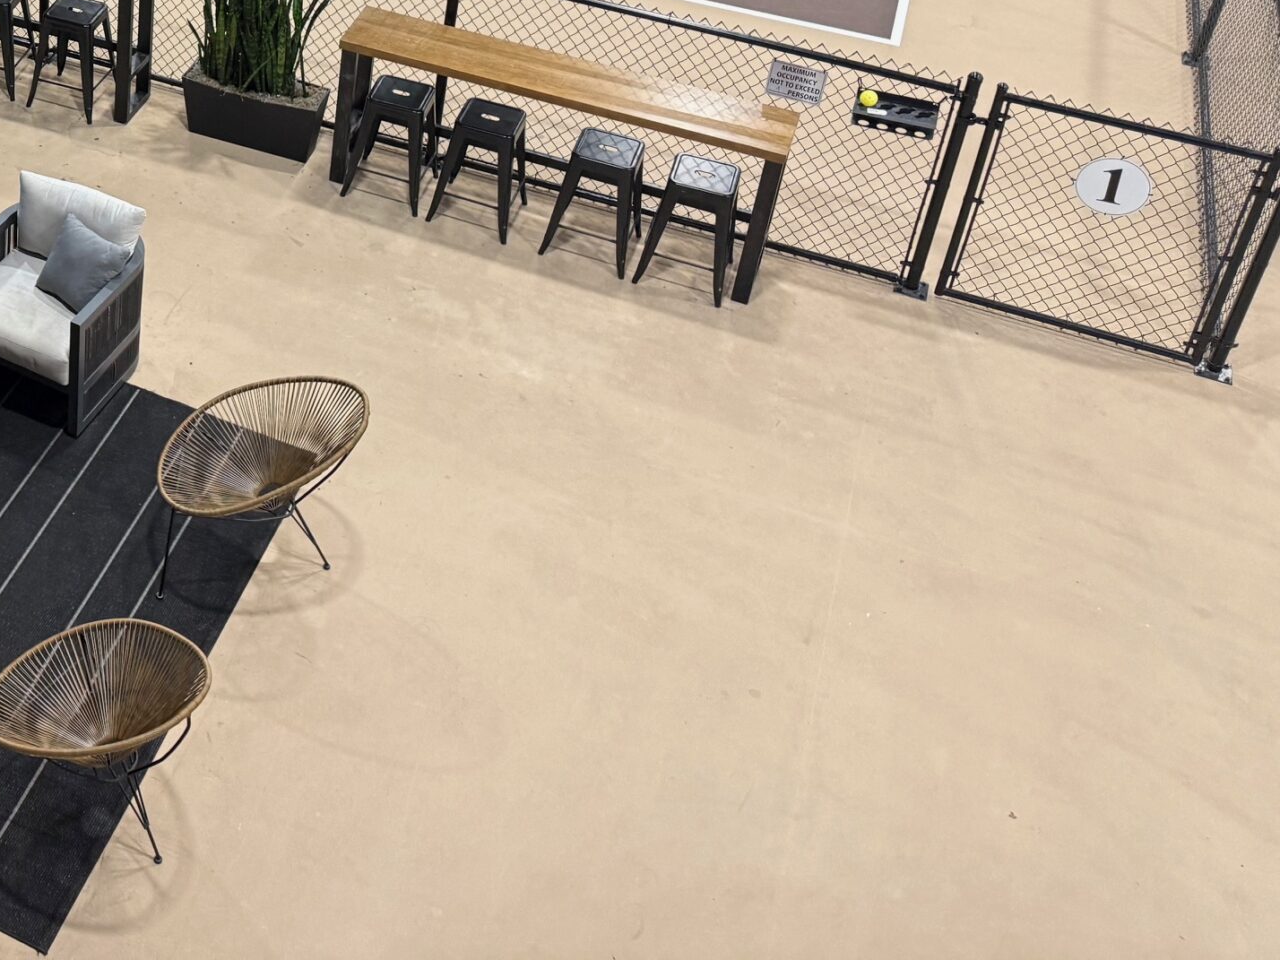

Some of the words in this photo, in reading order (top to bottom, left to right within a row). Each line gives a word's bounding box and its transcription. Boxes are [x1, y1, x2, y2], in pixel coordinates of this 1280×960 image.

[776, 71, 817, 86] OCCUPANCY
[781, 64, 816, 78] MAXIMUM
[769, 77, 783, 86] NOT
[795, 84, 820, 95] EXCEED
[787, 89, 819, 102] PERSONS
[1096, 168, 1123, 206] 1
